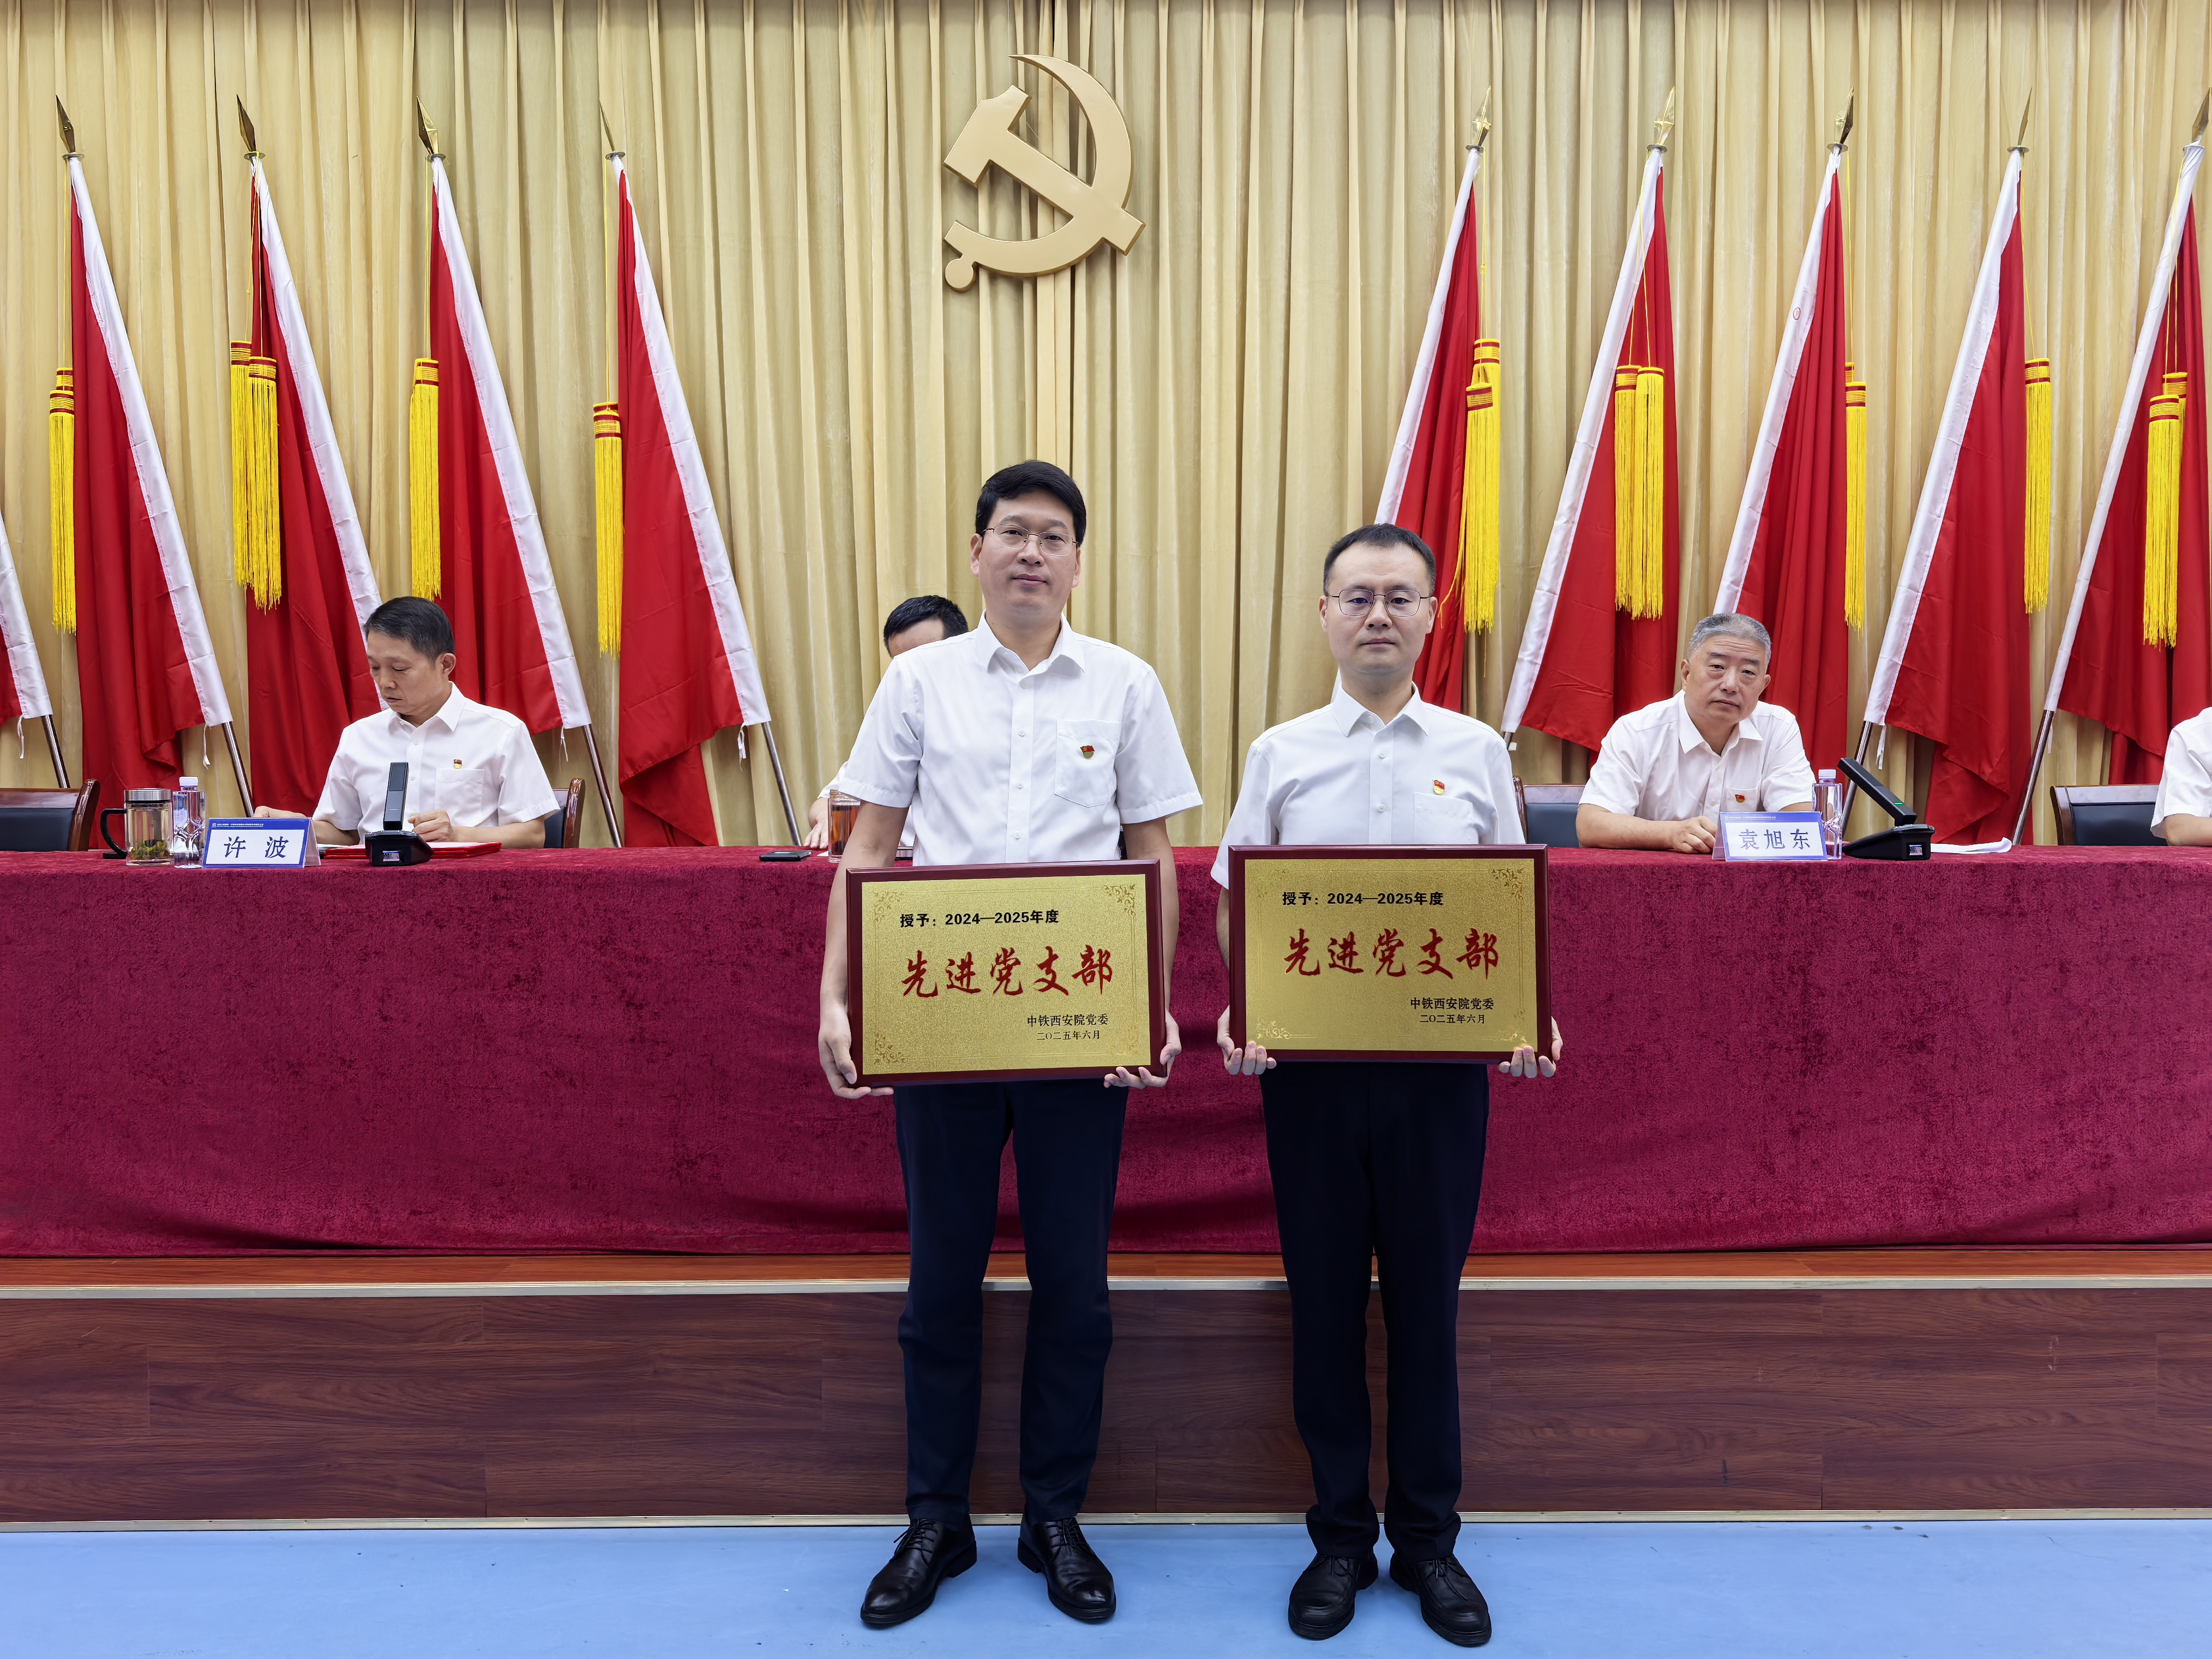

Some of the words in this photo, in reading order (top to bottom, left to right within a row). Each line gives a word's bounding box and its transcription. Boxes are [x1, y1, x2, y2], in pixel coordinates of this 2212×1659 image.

[1738, 828, 1810, 849] 袁旭东
[1284, 928, 1499, 979] 先进党支部
[901, 944, 1113, 999] 先进党支部
[1410, 997, 1495, 1010] 中铁西安院党委
[1027, 1013, 1109, 1028] 中铁西安院党委
